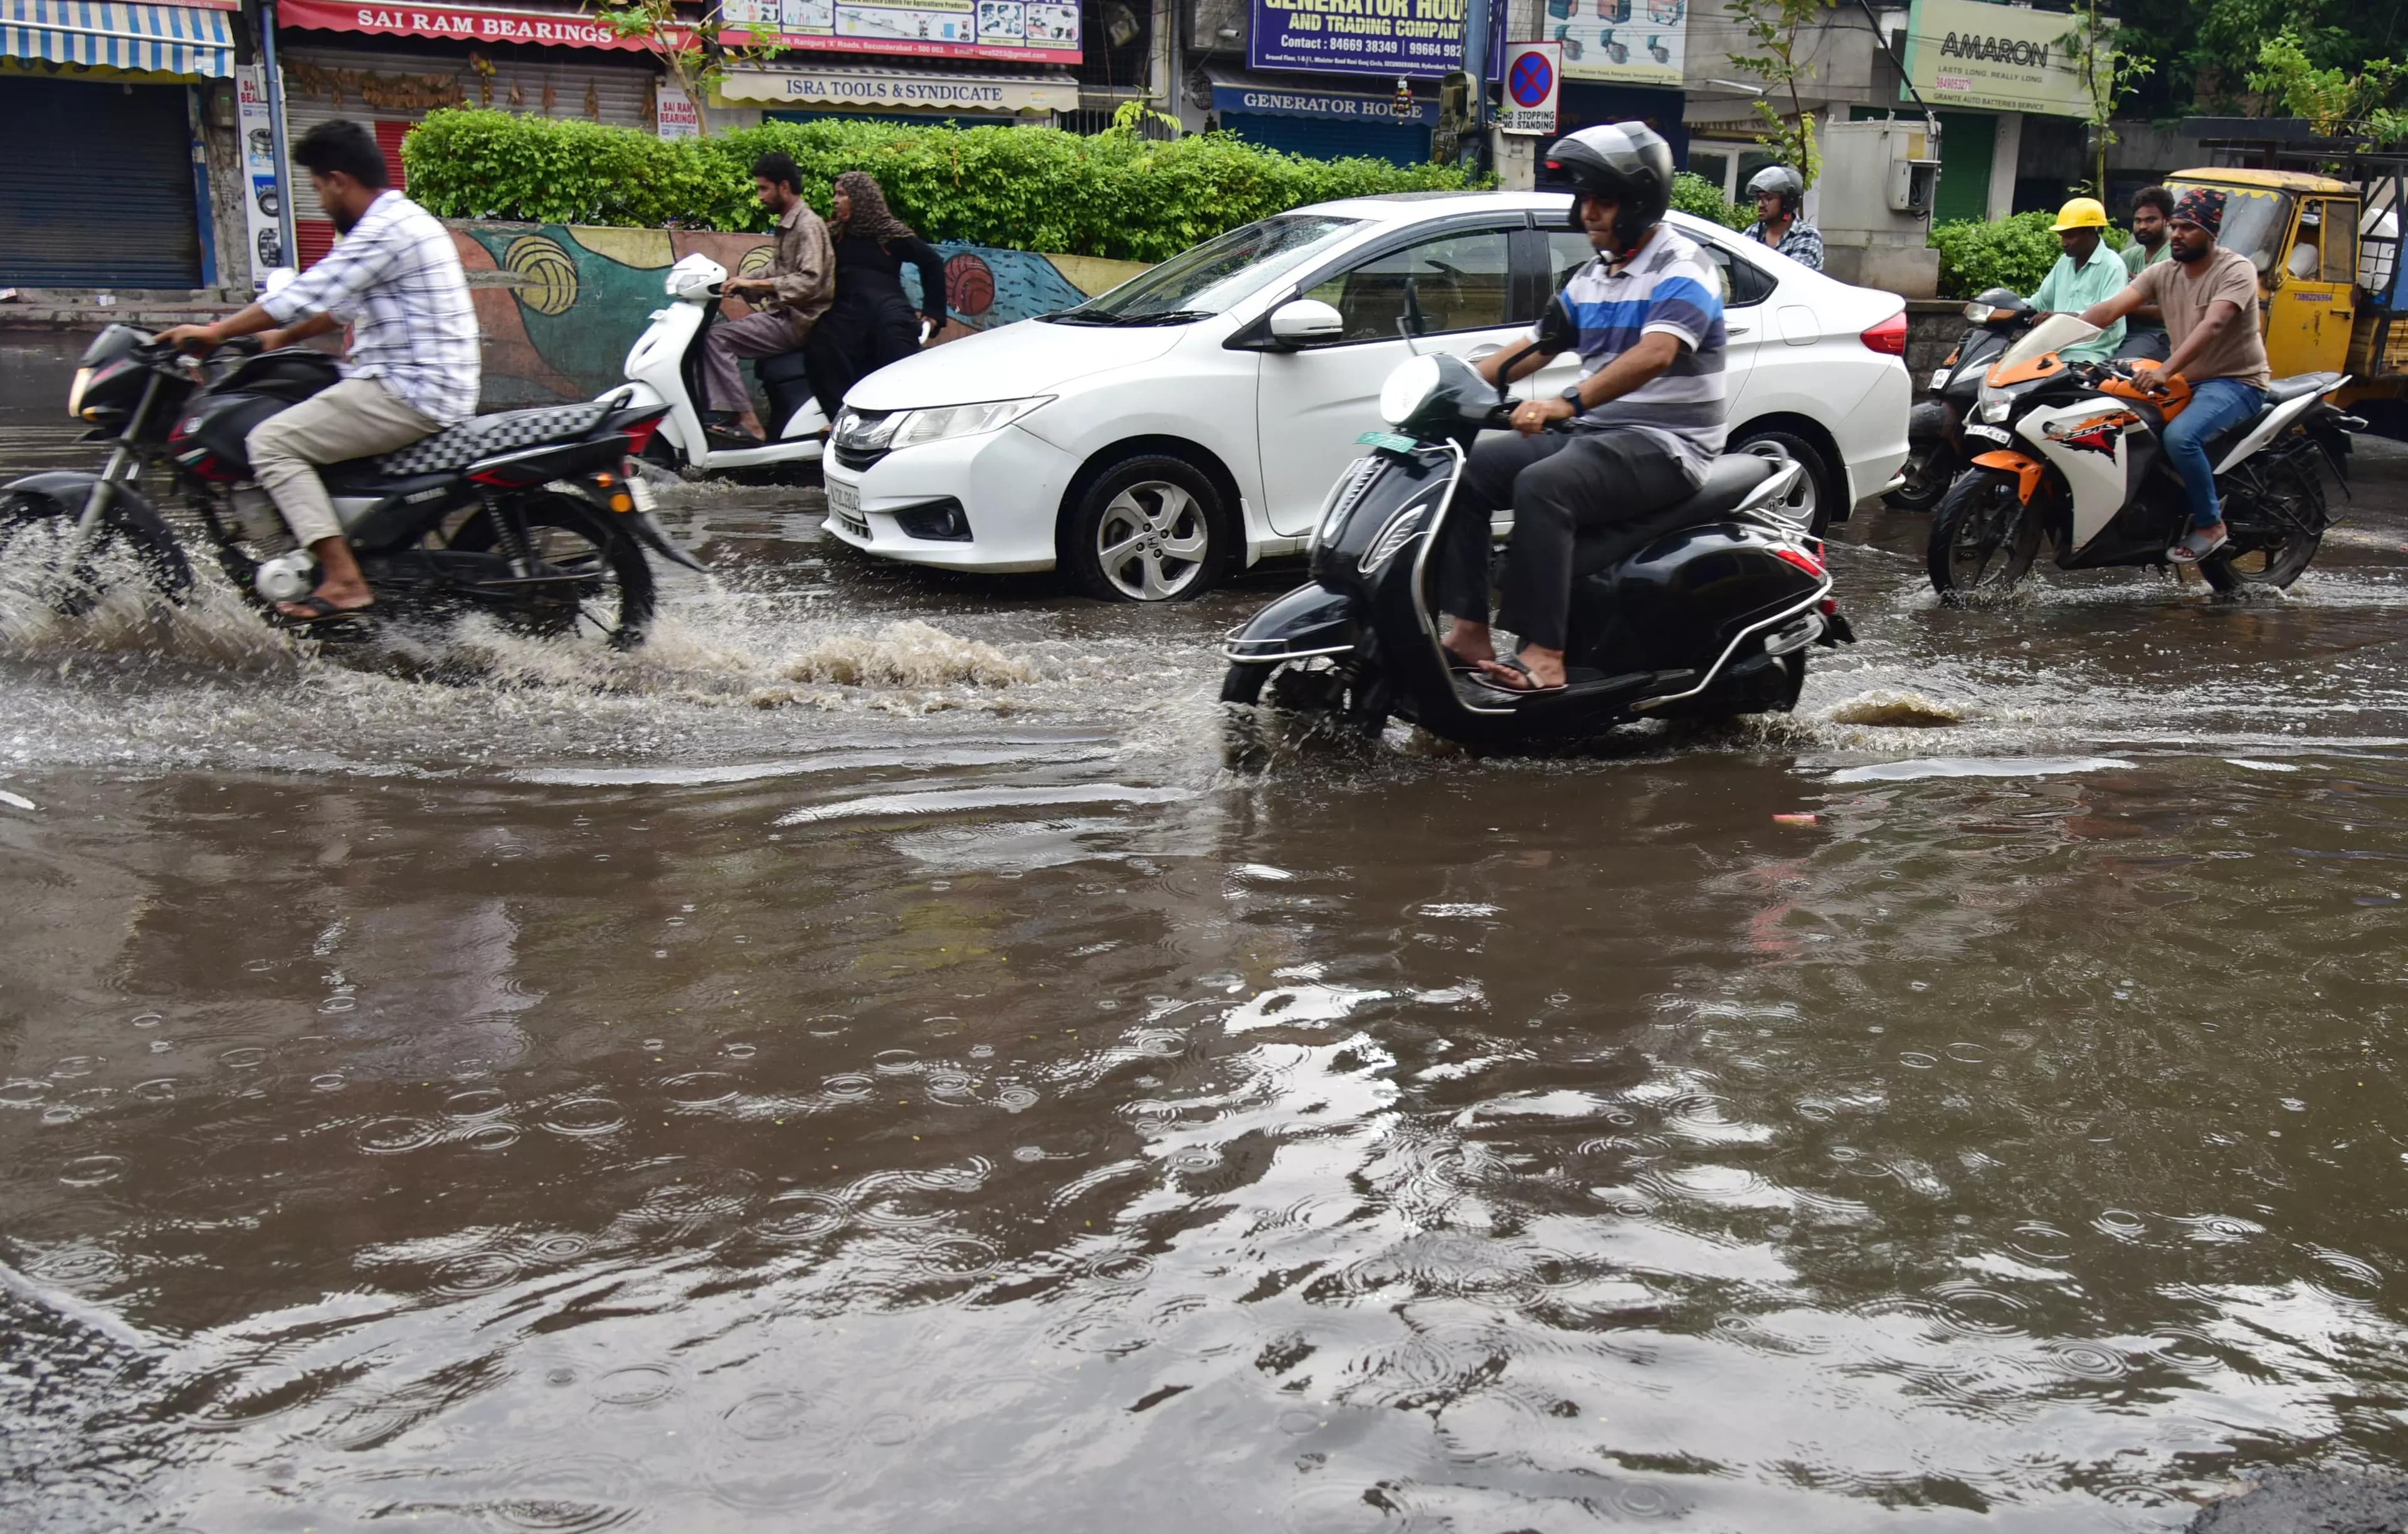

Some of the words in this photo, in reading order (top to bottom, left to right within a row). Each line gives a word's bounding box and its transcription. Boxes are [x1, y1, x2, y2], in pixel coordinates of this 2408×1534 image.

[913, 1, 944, 9] Agriculture
[1416, 0, 1469, 20] HOU
[357, 9, 404, 28] SAI
[411, 13, 475, 33] RAM
[482, 18, 613, 43] BEARINGS
[1288, 13, 1322, 31] AND
[1325, 14, 1392, 36] TRADING
[1395, 19, 1462, 40] COMPAN
[794, 38, 826, 48] Ranigunj
[837, 41, 862, 50] Roads,
[863, 42, 912, 52] Secunderabad
[1281, 34, 1322, 50] Contact
[1329, 38, 1363, 52] 84669
[1365, 40, 1398, 54] 38349
[1409, 42, 1442, 56] 99664
[1443, 44, 1465, 58] 982
[1940, 32, 2049, 68] AMARON
[1938, 65, 1962, 75] LASTS
[1990, 70, 2019, 81] REALLY
[2021, 73, 2042, 83] LONG
[786, 80, 827, 95] ISRA
[831, 82, 887, 98] TOOLS
[892, 84, 904, 98] &
[906, 85, 1003, 102] SYNDICATE
[663, 102, 675, 112] SAI
[677, 102, 693, 113] RAM
[1244, 93, 1358, 114] GENERATOR
[1933, 92, 1962, 103] GRANITE
[1963, 95, 1981, 105] AUTO
[1982, 96, 2017, 108] BATTERIES
[2017, 100, 2044, 111] SERVICE
[660, 113, 697, 124] BEARINGS
[1502, 111, 1514, 120] NO
[1518, 110, 1555, 120] STOPPING
[1502, 120, 1513, 129] NO
[1517, 120, 1555, 130] STANDING
